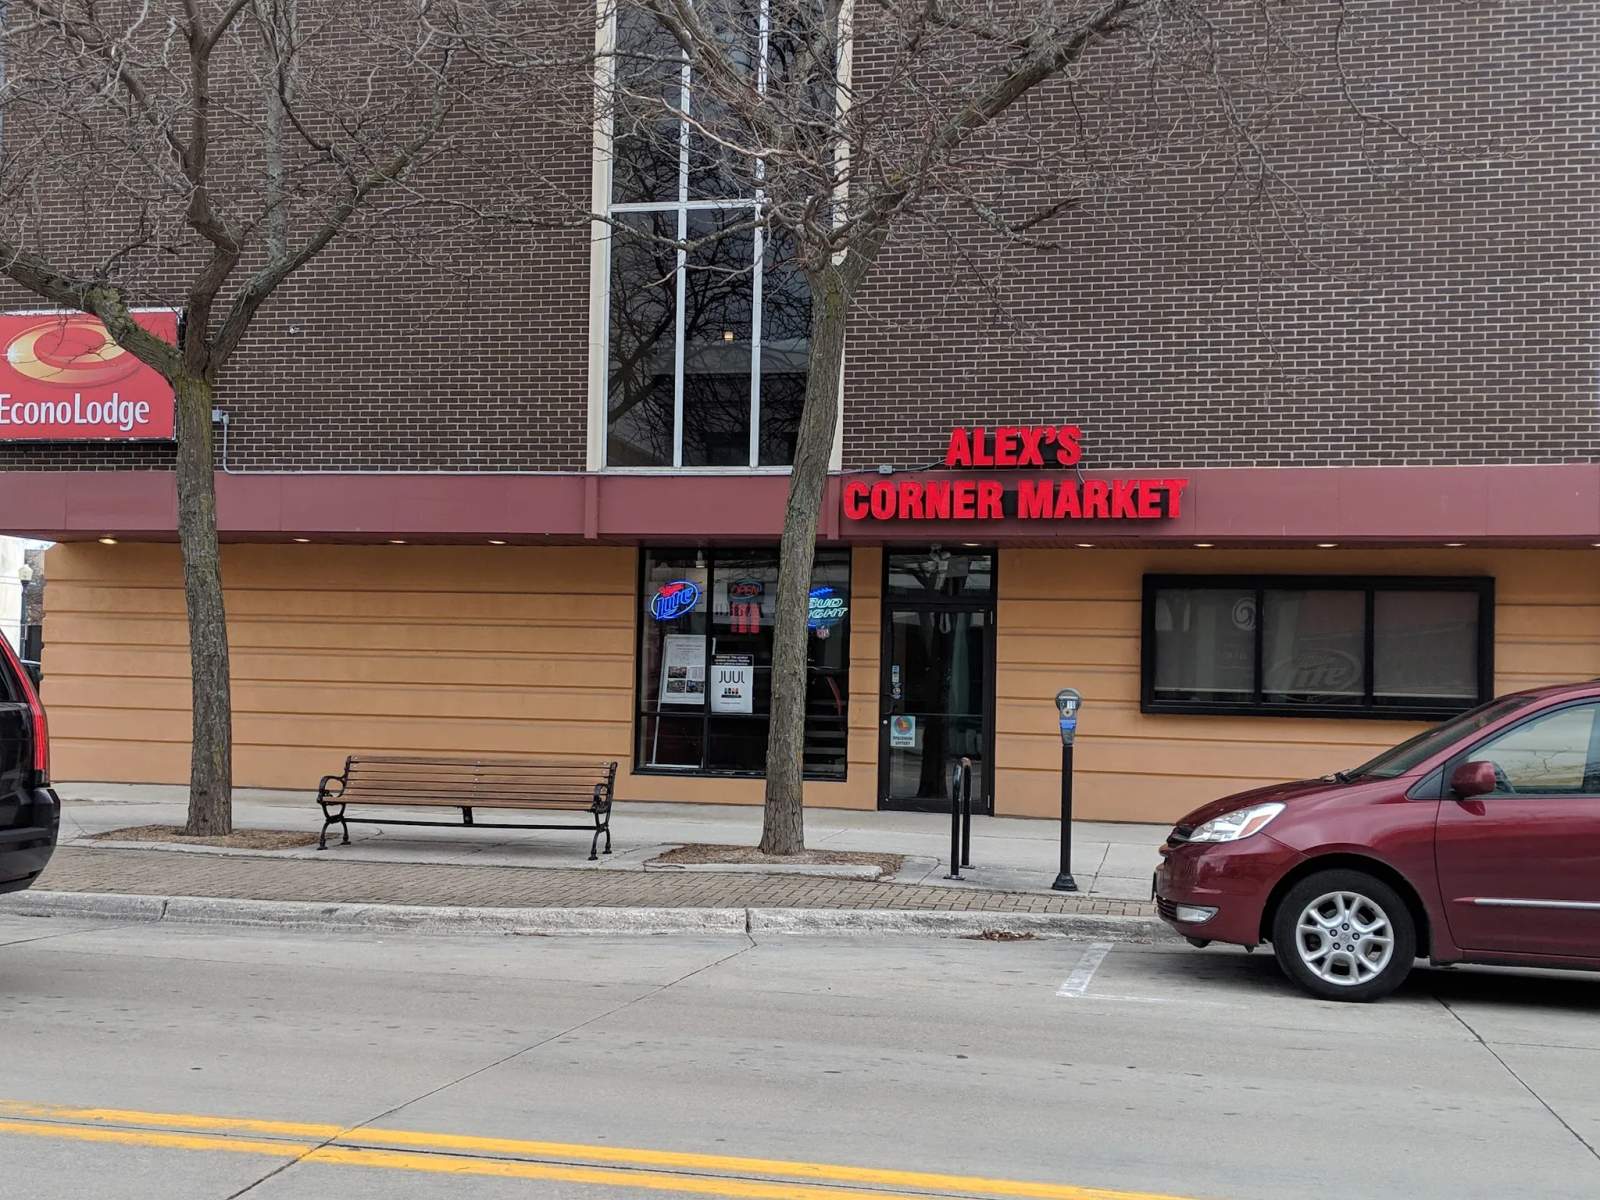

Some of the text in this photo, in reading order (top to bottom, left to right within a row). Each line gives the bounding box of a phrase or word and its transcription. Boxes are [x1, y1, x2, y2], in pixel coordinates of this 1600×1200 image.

[945, 425, 1083, 467] ALEX'S
[843, 479, 1190, 520] CORNER MARKET
[808, 597, 843, 609] BUD
[807, 607, 848, 619] IGHT
[718, 669, 745, 684] JUUL
